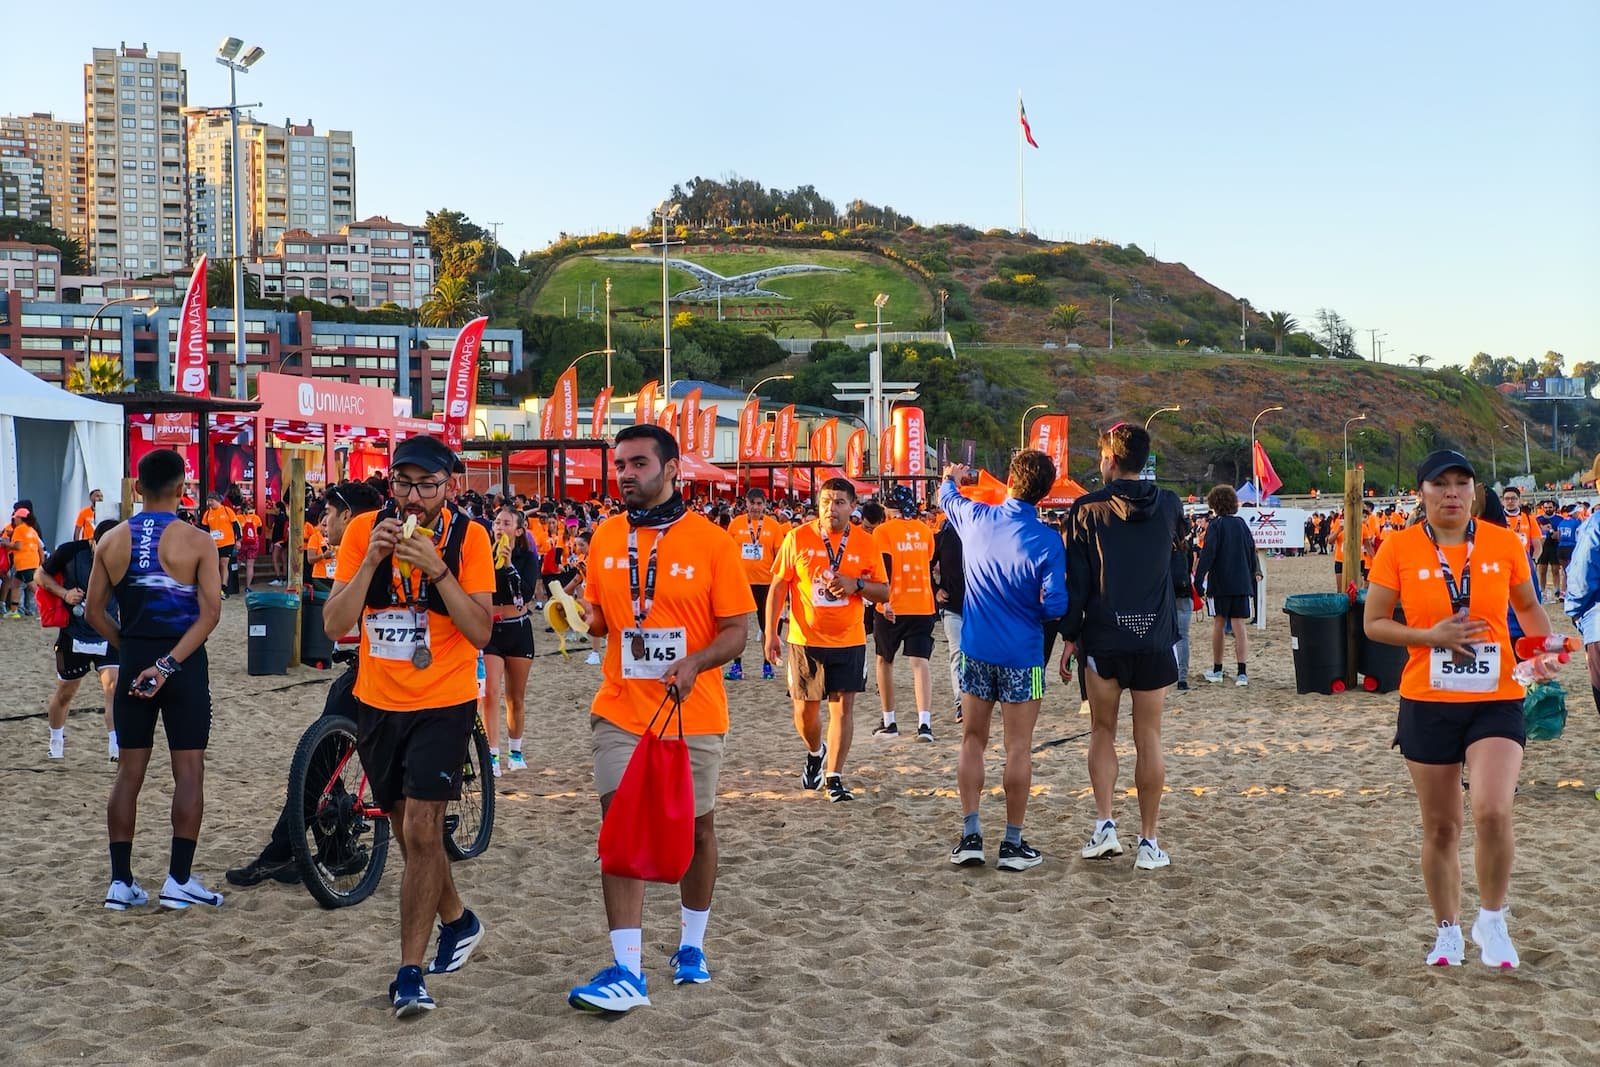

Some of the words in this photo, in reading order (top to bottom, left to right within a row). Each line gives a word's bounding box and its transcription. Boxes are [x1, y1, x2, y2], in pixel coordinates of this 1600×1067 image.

[456, 335, 476, 397] UNIMARC
[315, 391, 365, 415] UNIMARC
[157, 425, 190, 434] FRUTAS
[139, 519, 155, 569] SPAYKS
[634, 647, 676, 661] 145
